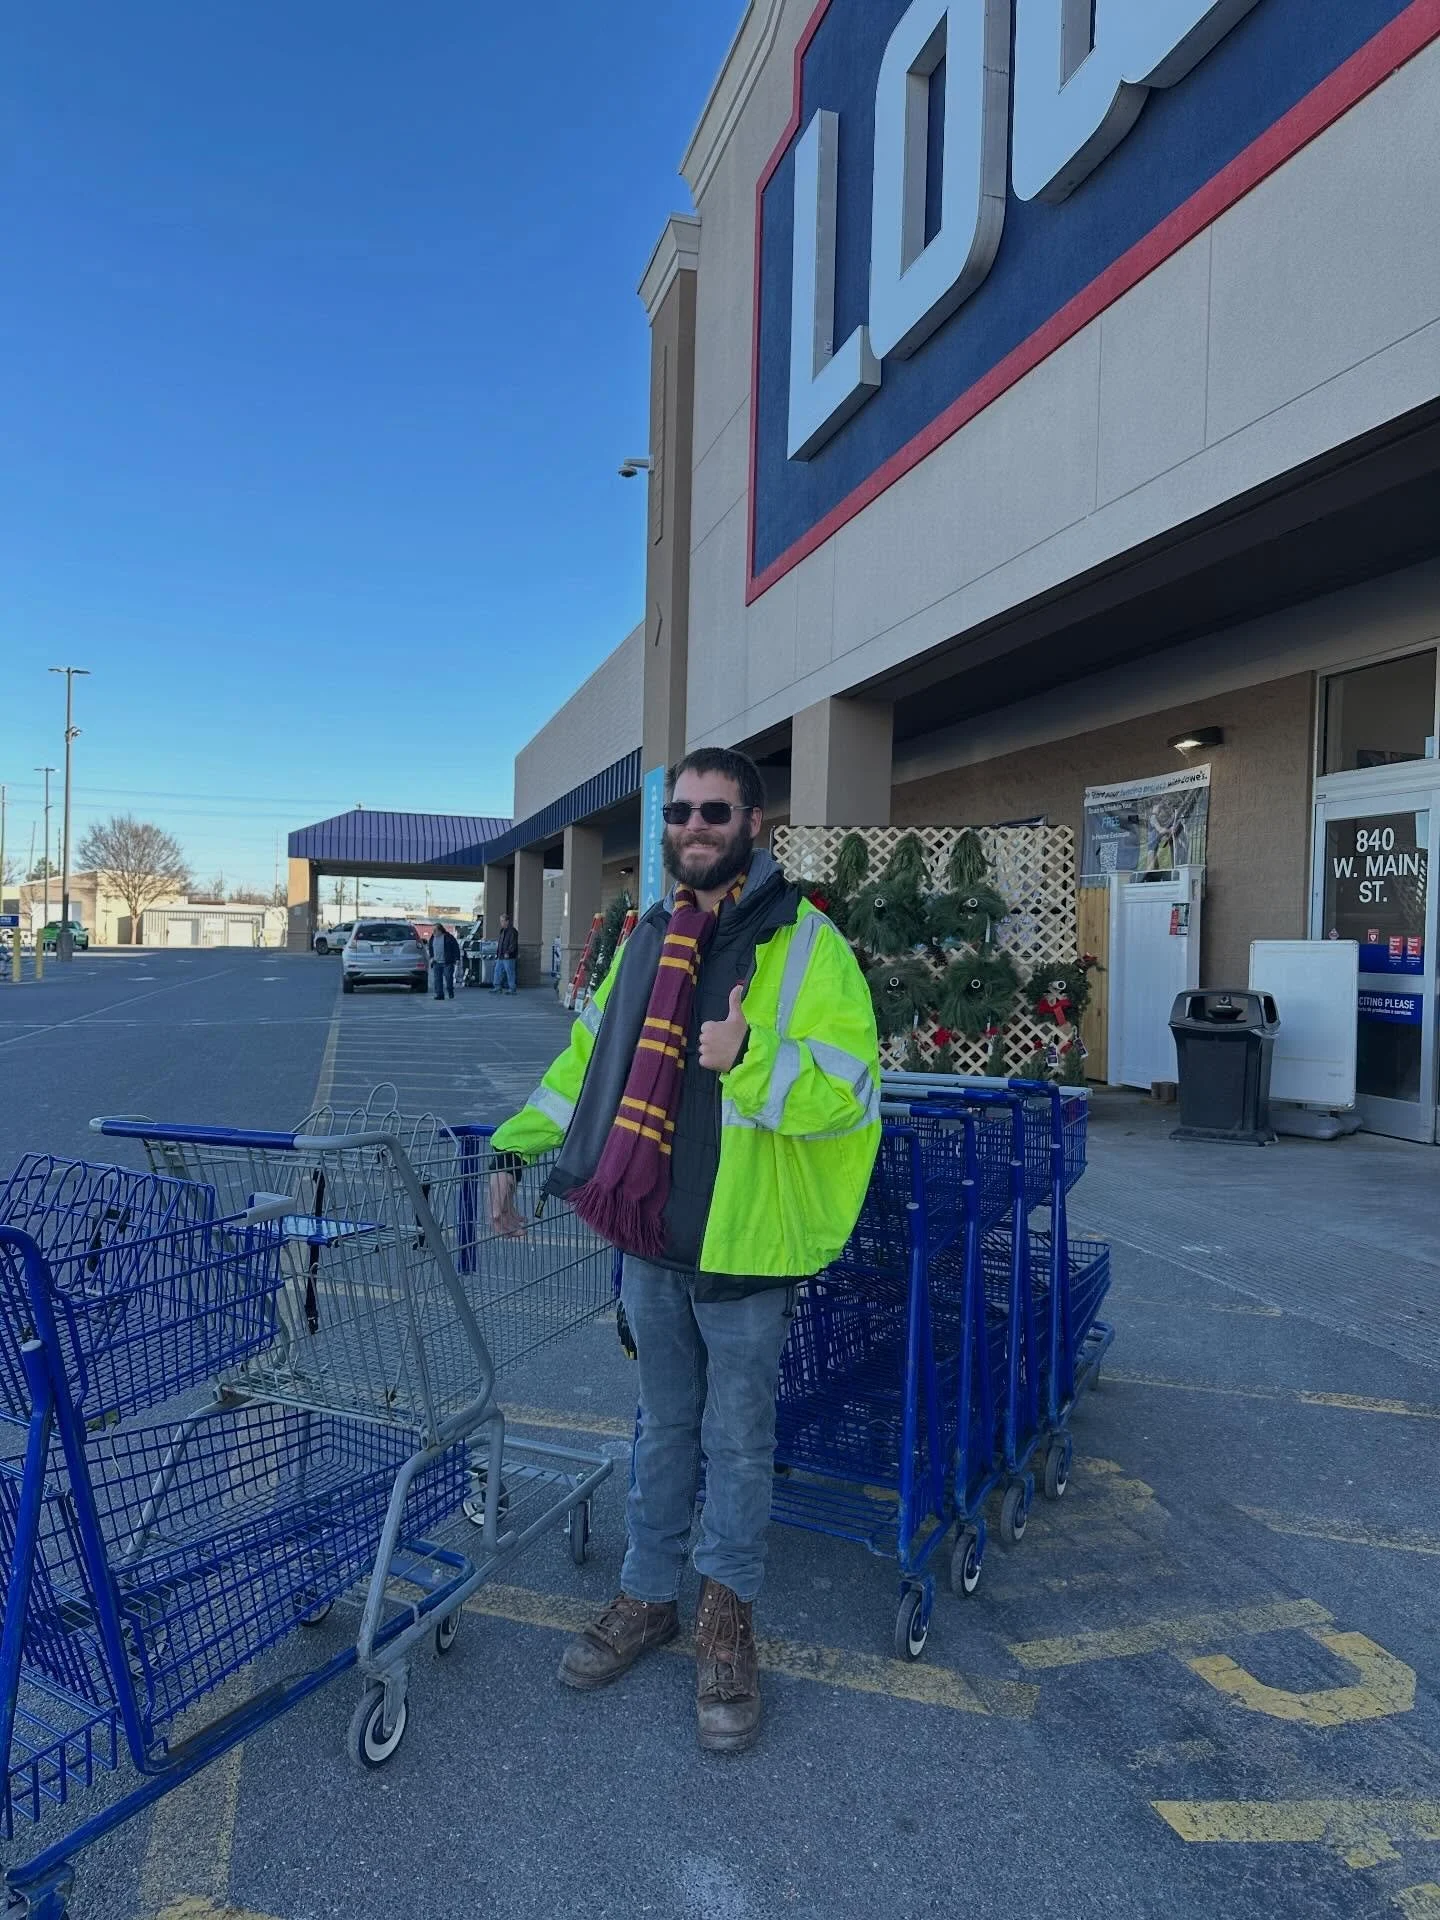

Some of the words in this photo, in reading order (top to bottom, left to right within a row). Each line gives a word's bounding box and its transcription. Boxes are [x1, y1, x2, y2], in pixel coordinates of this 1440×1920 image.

[1356, 827, 1395, 853] 840
[1333, 857, 1358, 879] W.
[1365, 852, 1419, 877] MAIN
[1358, 880, 1388, 903] ST.
[1384, 998, 1415, 1010] PLEASE
